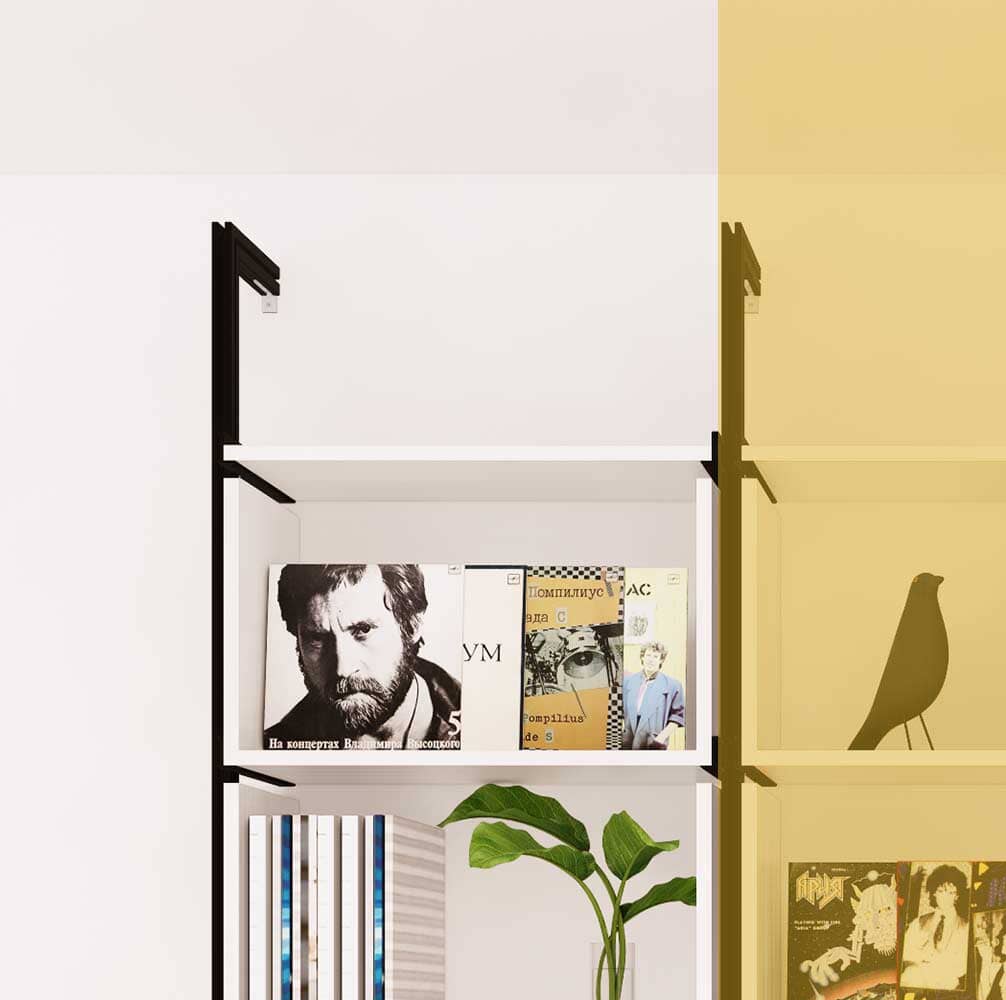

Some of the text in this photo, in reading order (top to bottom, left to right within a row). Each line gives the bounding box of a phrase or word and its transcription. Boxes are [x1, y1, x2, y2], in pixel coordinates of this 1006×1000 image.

[528, 586, 604, 600] Помпилиус
[626, 583, 651, 596] АС
[462, 643, 502, 662] УМ
[447, 711, 461, 735] 5
[269, 738, 460, 750] На концертах Владимира Высоцкого
